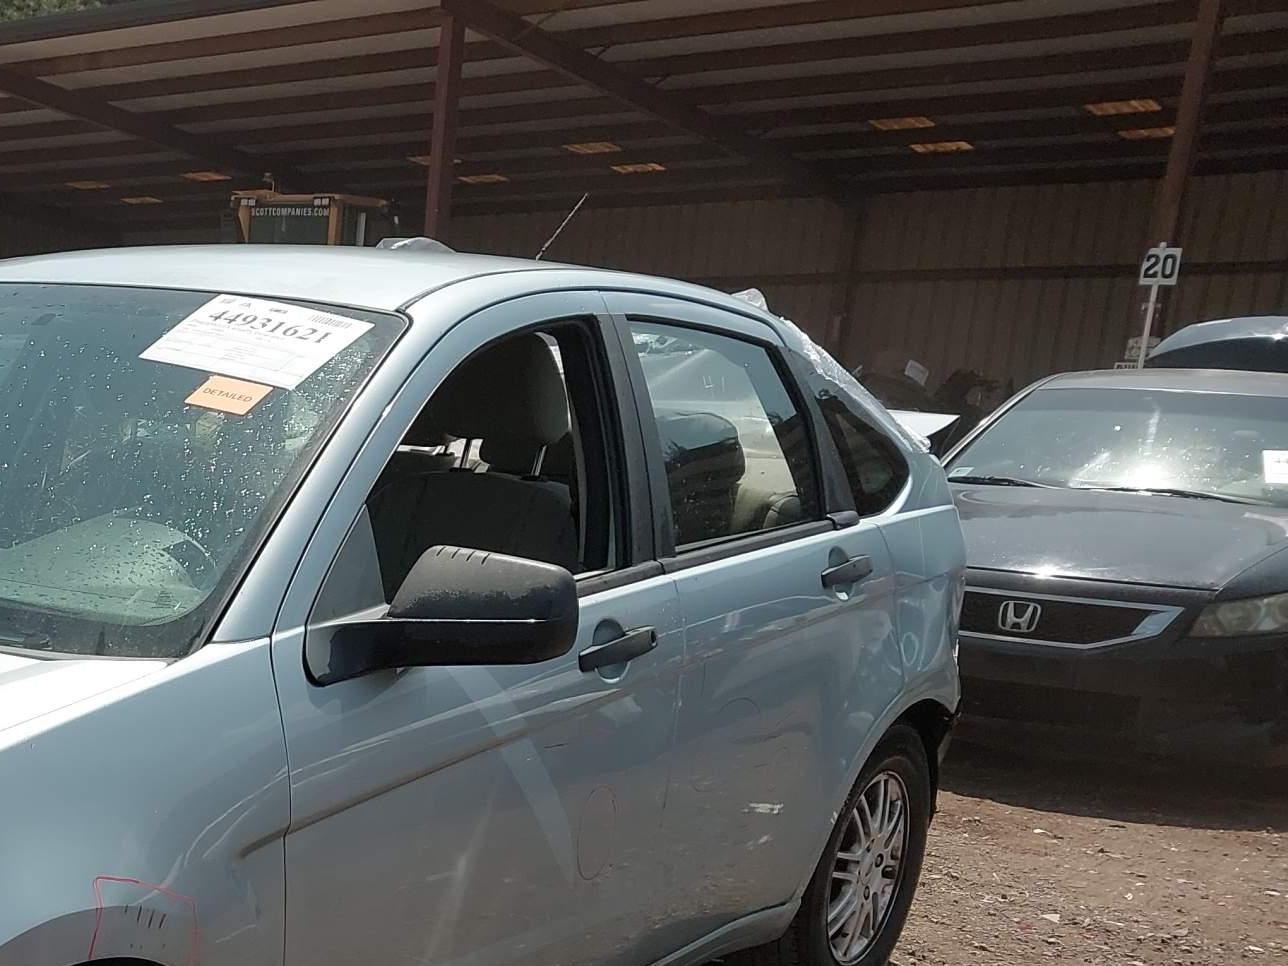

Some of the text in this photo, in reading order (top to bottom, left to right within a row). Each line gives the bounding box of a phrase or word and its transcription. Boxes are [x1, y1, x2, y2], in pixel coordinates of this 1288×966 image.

[251, 207, 330, 217] SCOTTCOMPANIES.COM
[1143, 254, 1177, 279] 20
[208, 310, 332, 343] 44931621
[202, 387, 253, 403] DETAILED
